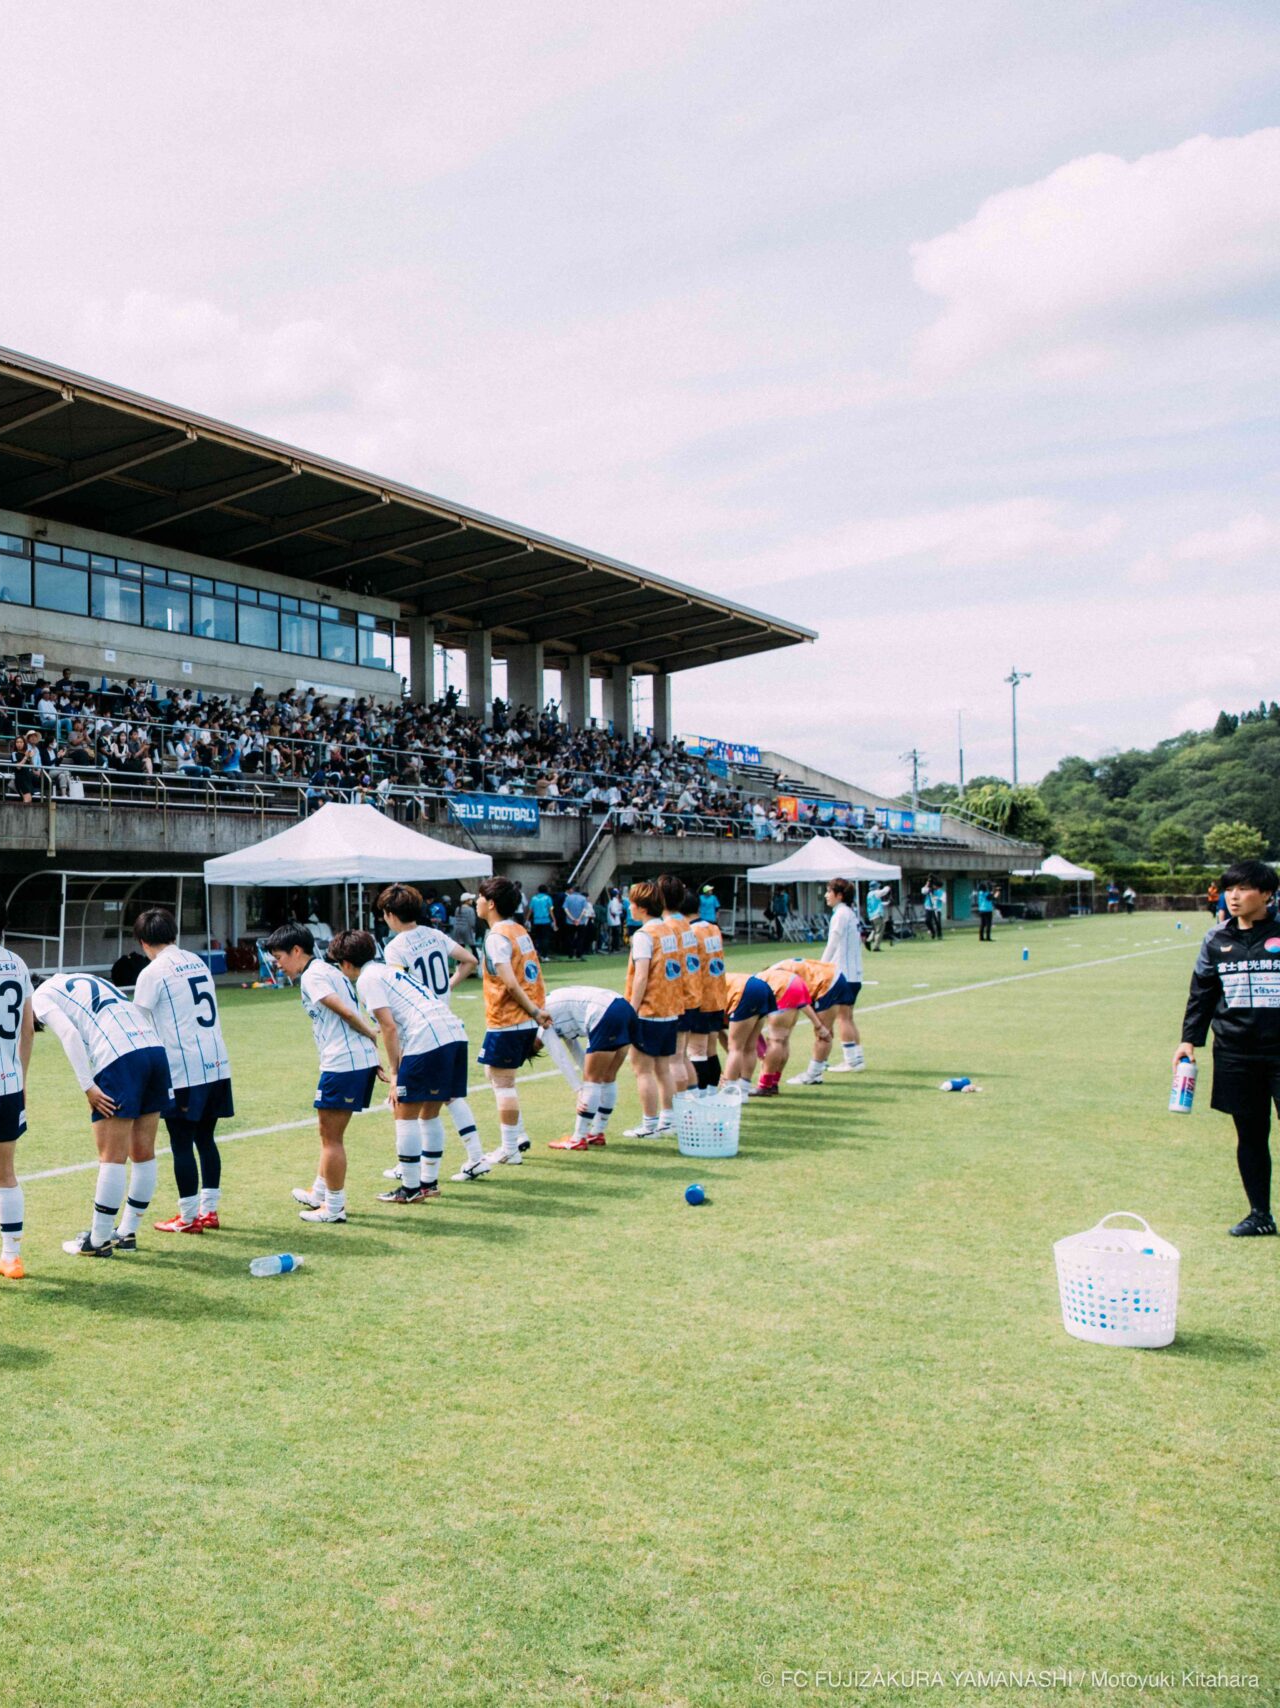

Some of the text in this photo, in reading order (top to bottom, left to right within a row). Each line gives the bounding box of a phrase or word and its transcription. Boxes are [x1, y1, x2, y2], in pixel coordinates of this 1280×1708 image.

[488, 805, 536, 822] FOOTBALL
[414, 951, 449, 995] 10
[187, 975, 217, 1027] 5
